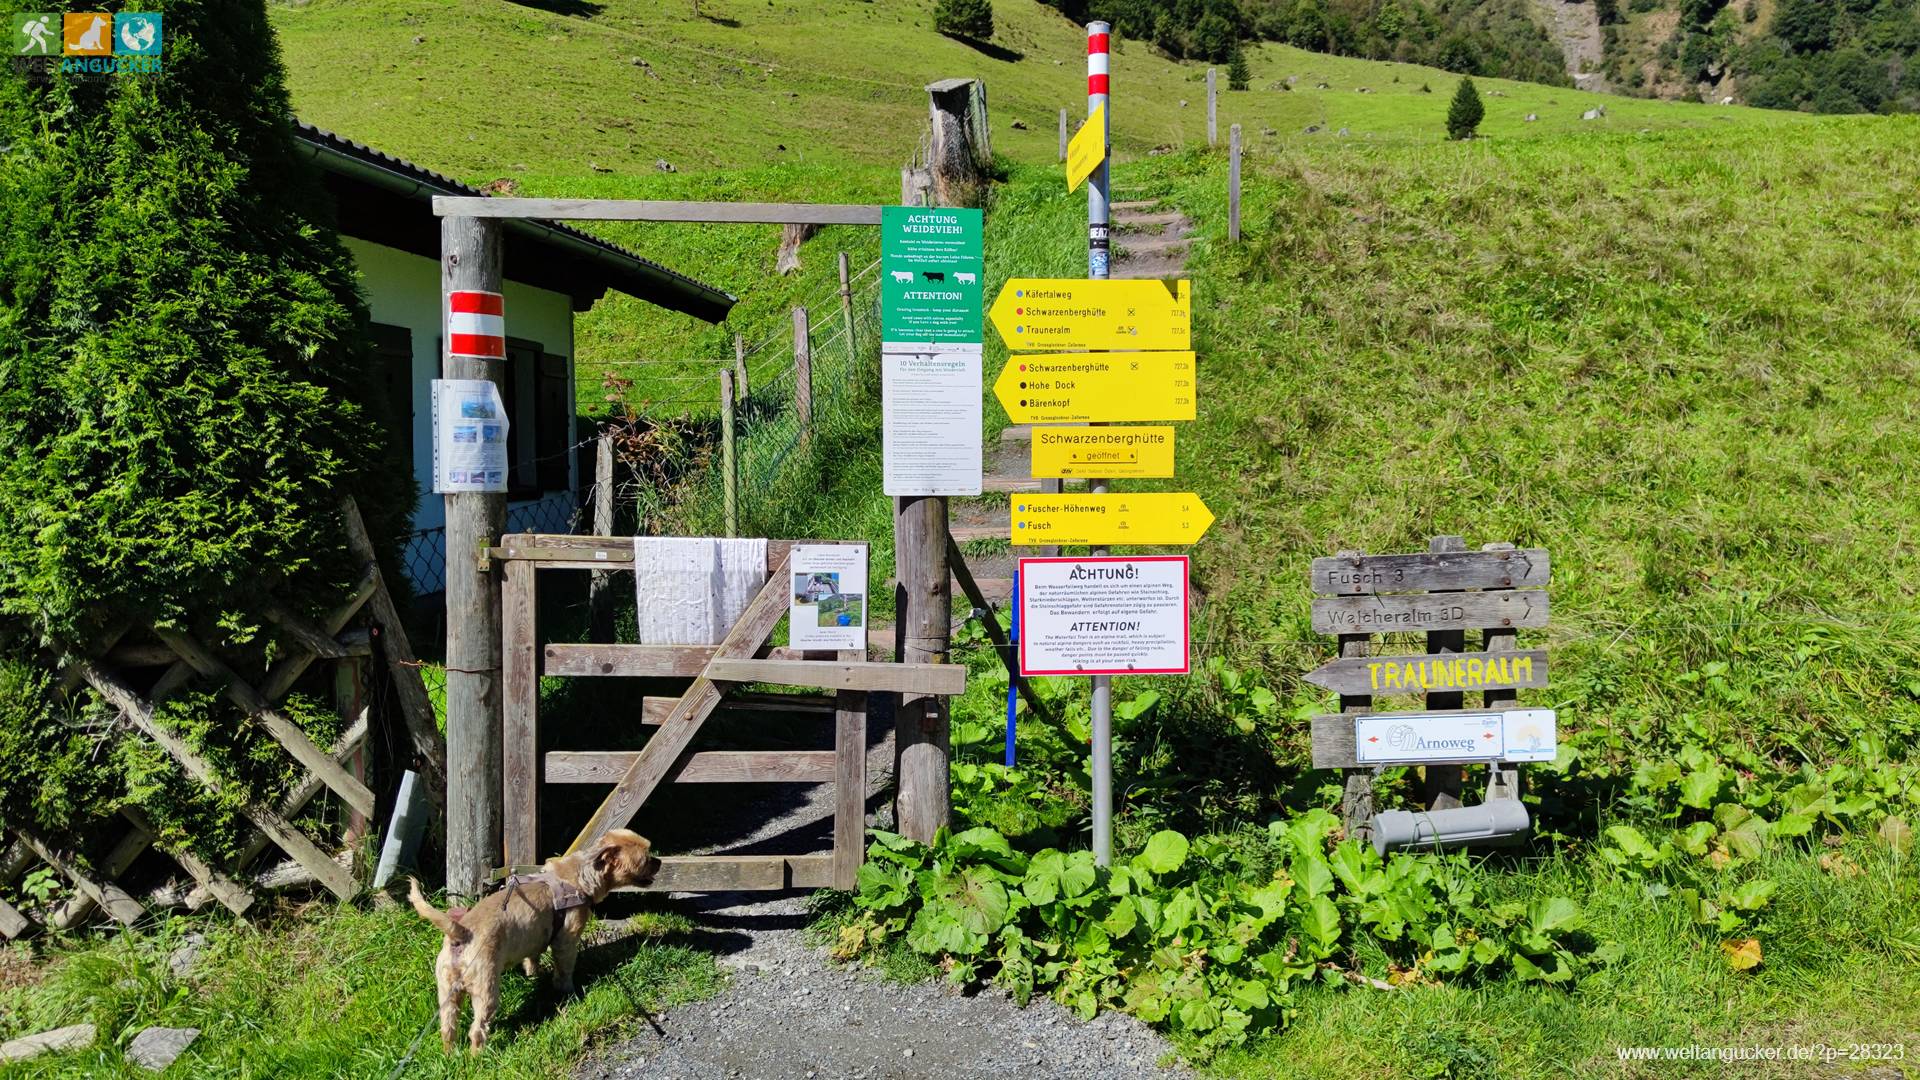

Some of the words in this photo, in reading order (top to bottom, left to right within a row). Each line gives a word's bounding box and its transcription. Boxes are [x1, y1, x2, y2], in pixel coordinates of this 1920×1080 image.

[908, 215, 957, 223] ACHTUNG
[903, 225, 963, 234] WEIDEVIEH!
[903, 291, 962, 300] ATTENTION!
[1025, 290, 1072, 300] Käfertalweg
[1026, 307, 1106, 318] Schwarzenberghütte
[1026, 326, 1071, 334] Trauneralm
[1029, 363, 1110, 374] Schwarzenberghütte
[1029, 380, 1050, 390] Hohe
[1055, 380, 1075, 389] Dock
[1029, 398, 1070, 409] Bärenkopf
[1041, 433, 1165, 445] Schwarzenberghütte
[1086, 451, 1120, 461] geöffnet
[1027, 504, 1106, 514] Fuscher-Höhenweg
[1027, 521, 1052, 530] Fusch
[1069, 568, 1139, 580] ACHTUNG!
[1327, 568, 1382, 585] Fusch
[1394, 568, 1404, 583] 3
[1327, 607, 1432, 626] Walcheralm
[1070, 621, 1141, 632] ATTENTION!
[1367, 655, 1533, 690] TRAUNERALM
[1416, 735, 1476, 753] Arnoweg
